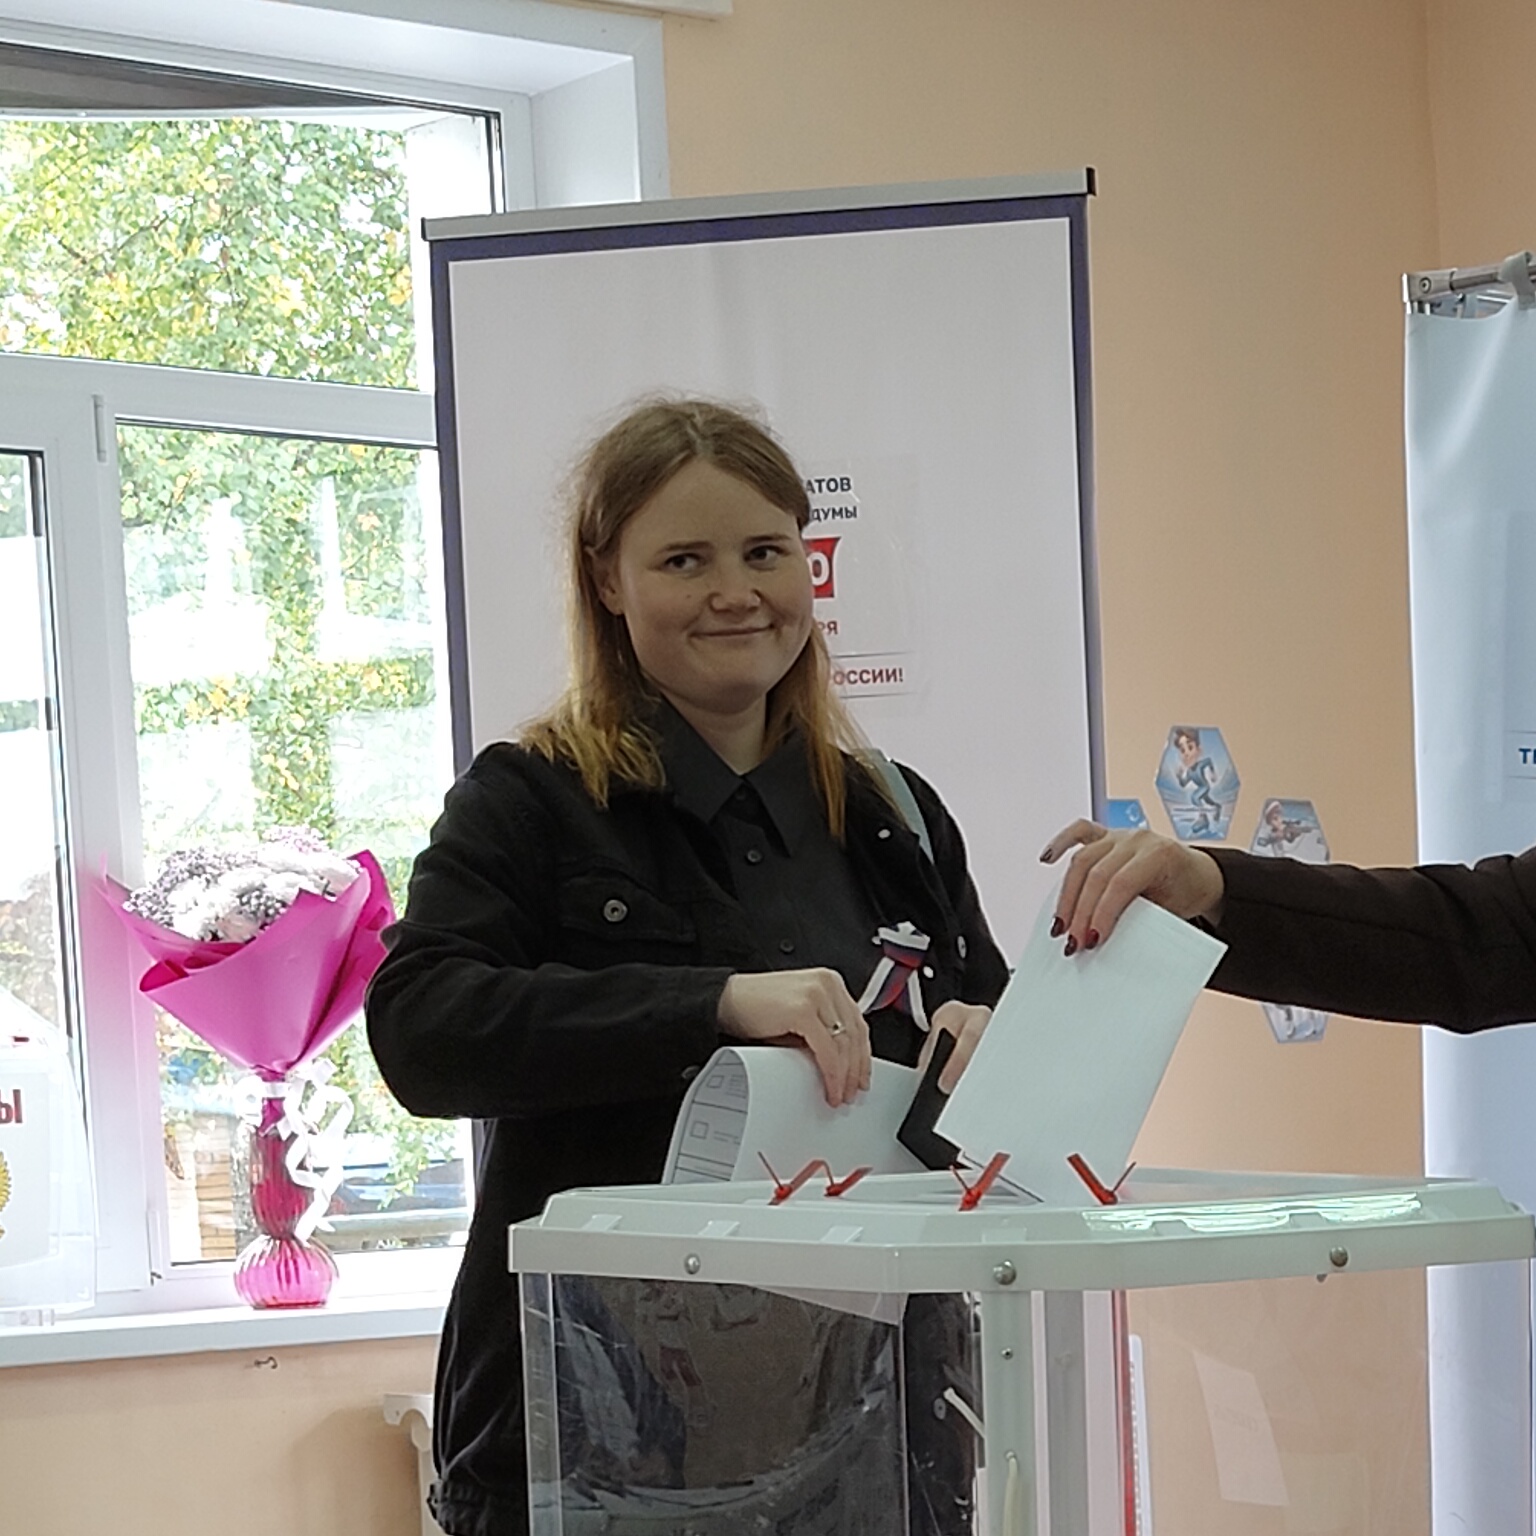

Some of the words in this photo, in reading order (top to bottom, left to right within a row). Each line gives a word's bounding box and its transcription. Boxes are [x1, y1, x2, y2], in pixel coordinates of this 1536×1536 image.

[806, 477, 851, 494] АТОВ
[808, 551, 830, 586] 0
[833, 667, 904, 685] ОССИИ!
